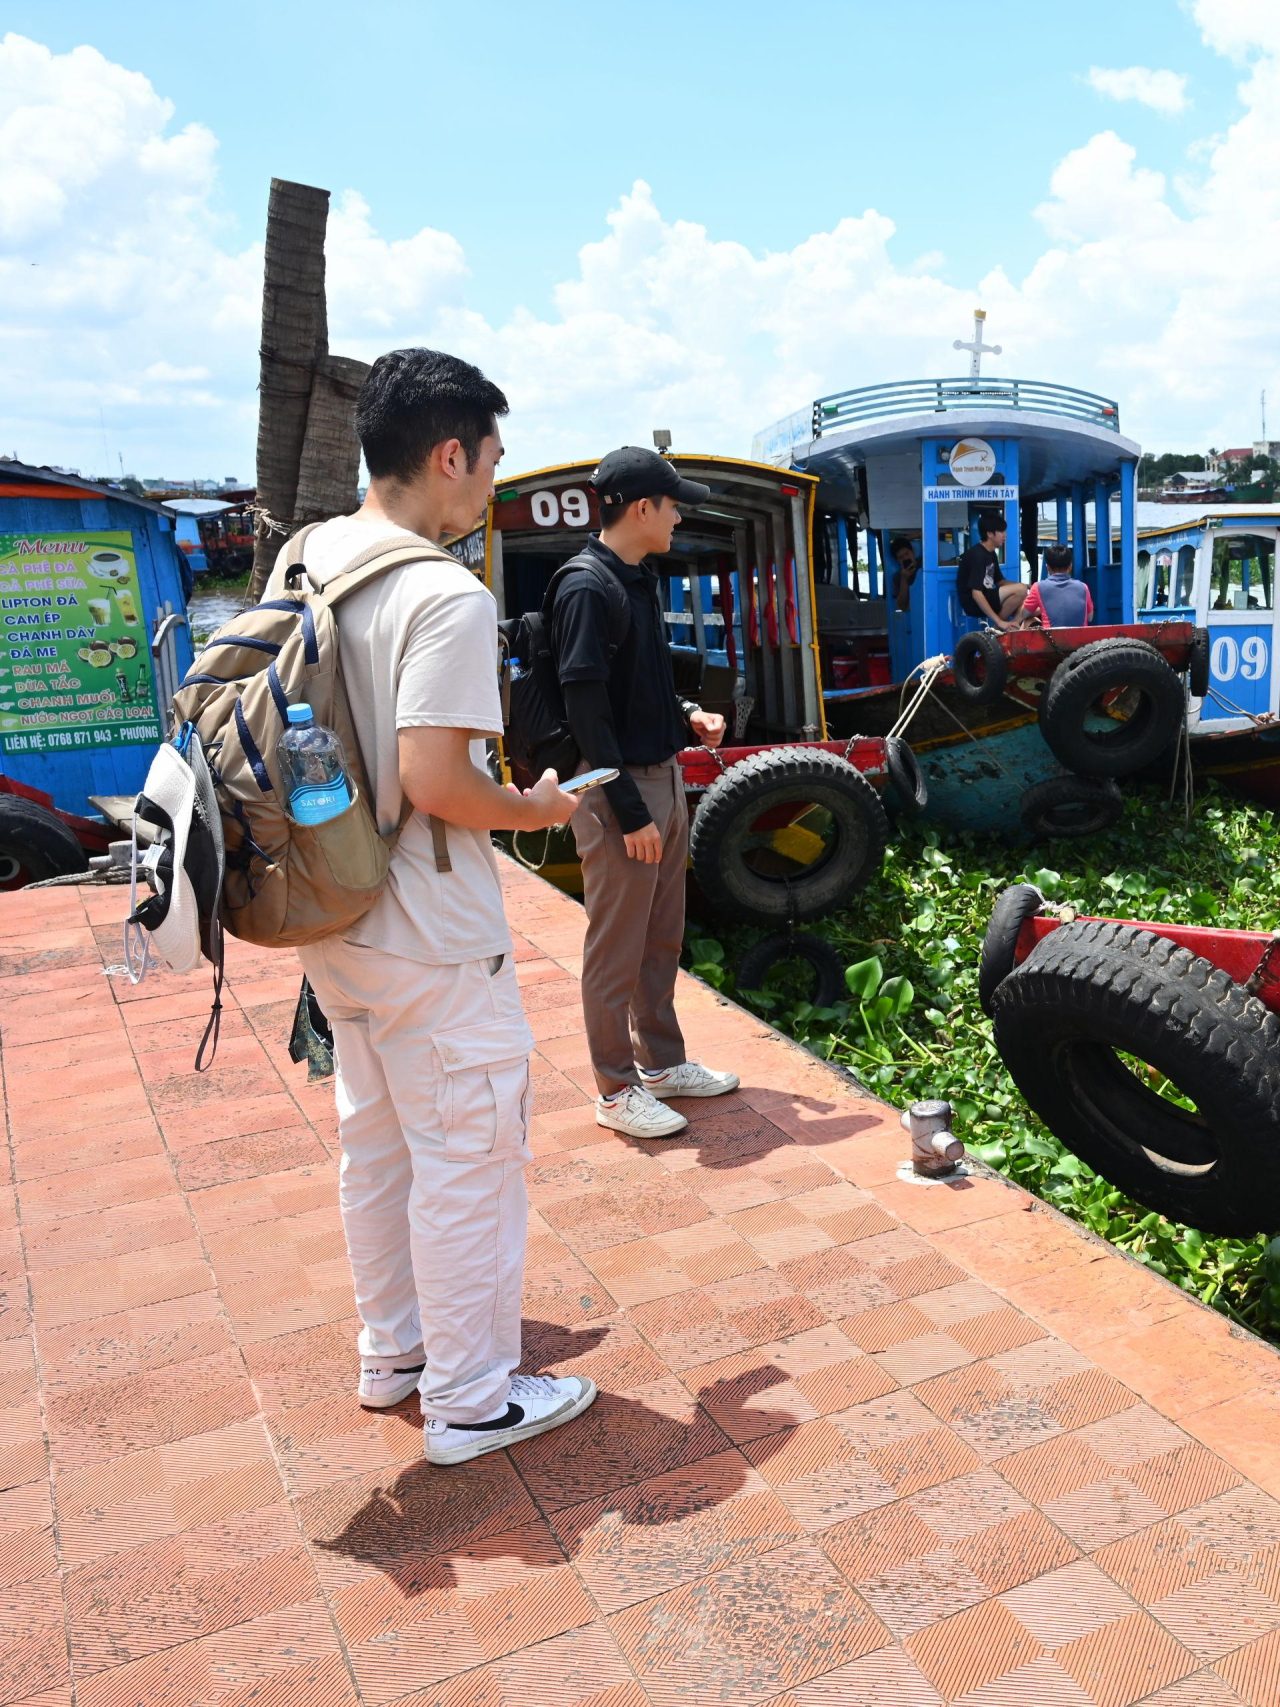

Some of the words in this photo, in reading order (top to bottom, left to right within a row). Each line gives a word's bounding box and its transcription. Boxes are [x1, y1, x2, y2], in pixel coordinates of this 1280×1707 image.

[928, 489, 950, 499] HÀNH
[952, 488, 975, 499] TRÌNH
[1000, 487, 1015, 498] TÂY
[530, 489, 590, 527] 09
[13, 538, 89, 556] Menu
[0, 560, 19, 575] CÀ
[22, 560, 51, 575] PHÊ
[54, 559, 78, 574] ĐÁ
[0, 578, 22, 593] CÀ
[25, 577, 54, 592] PHÊ
[56, 576, 87, 591] SỮA
[1, 596, 53, 609] LIPTON
[56, 593, 78, 606] ĐÁ
[4, 614, 40, 626] CAM
[44, 611, 61, 624] ÉP
[7, 630, 62, 643] CHANH
[66, 626, 96, 640] DÂY
[10, 646, 33, 660] ĐÁ
[36, 647, 58, 658] ME
[1210, 636, 1269, 682] 09
[12, 664, 42, 677] RAU
[45, 659, 71, 674] MÁ
[50, 674, 81, 690] TẮC
[18, 695, 74, 709] CHANH
[76, 688, 116, 704] MUỐI
[21, 711, 57, 726] NƯỚC
[60, 708, 93, 724] NGỌT
[96, 706, 123, 720] CÁC
[5, 734, 28, 750] LIÊN
[30, 732, 46, 750] HỆ:
[48, 731, 72, 747] 0768
[74, 730, 91, 744] 871
[94, 729, 112, 743] 943
[120, 725, 158, 741] PHƯỢNG
